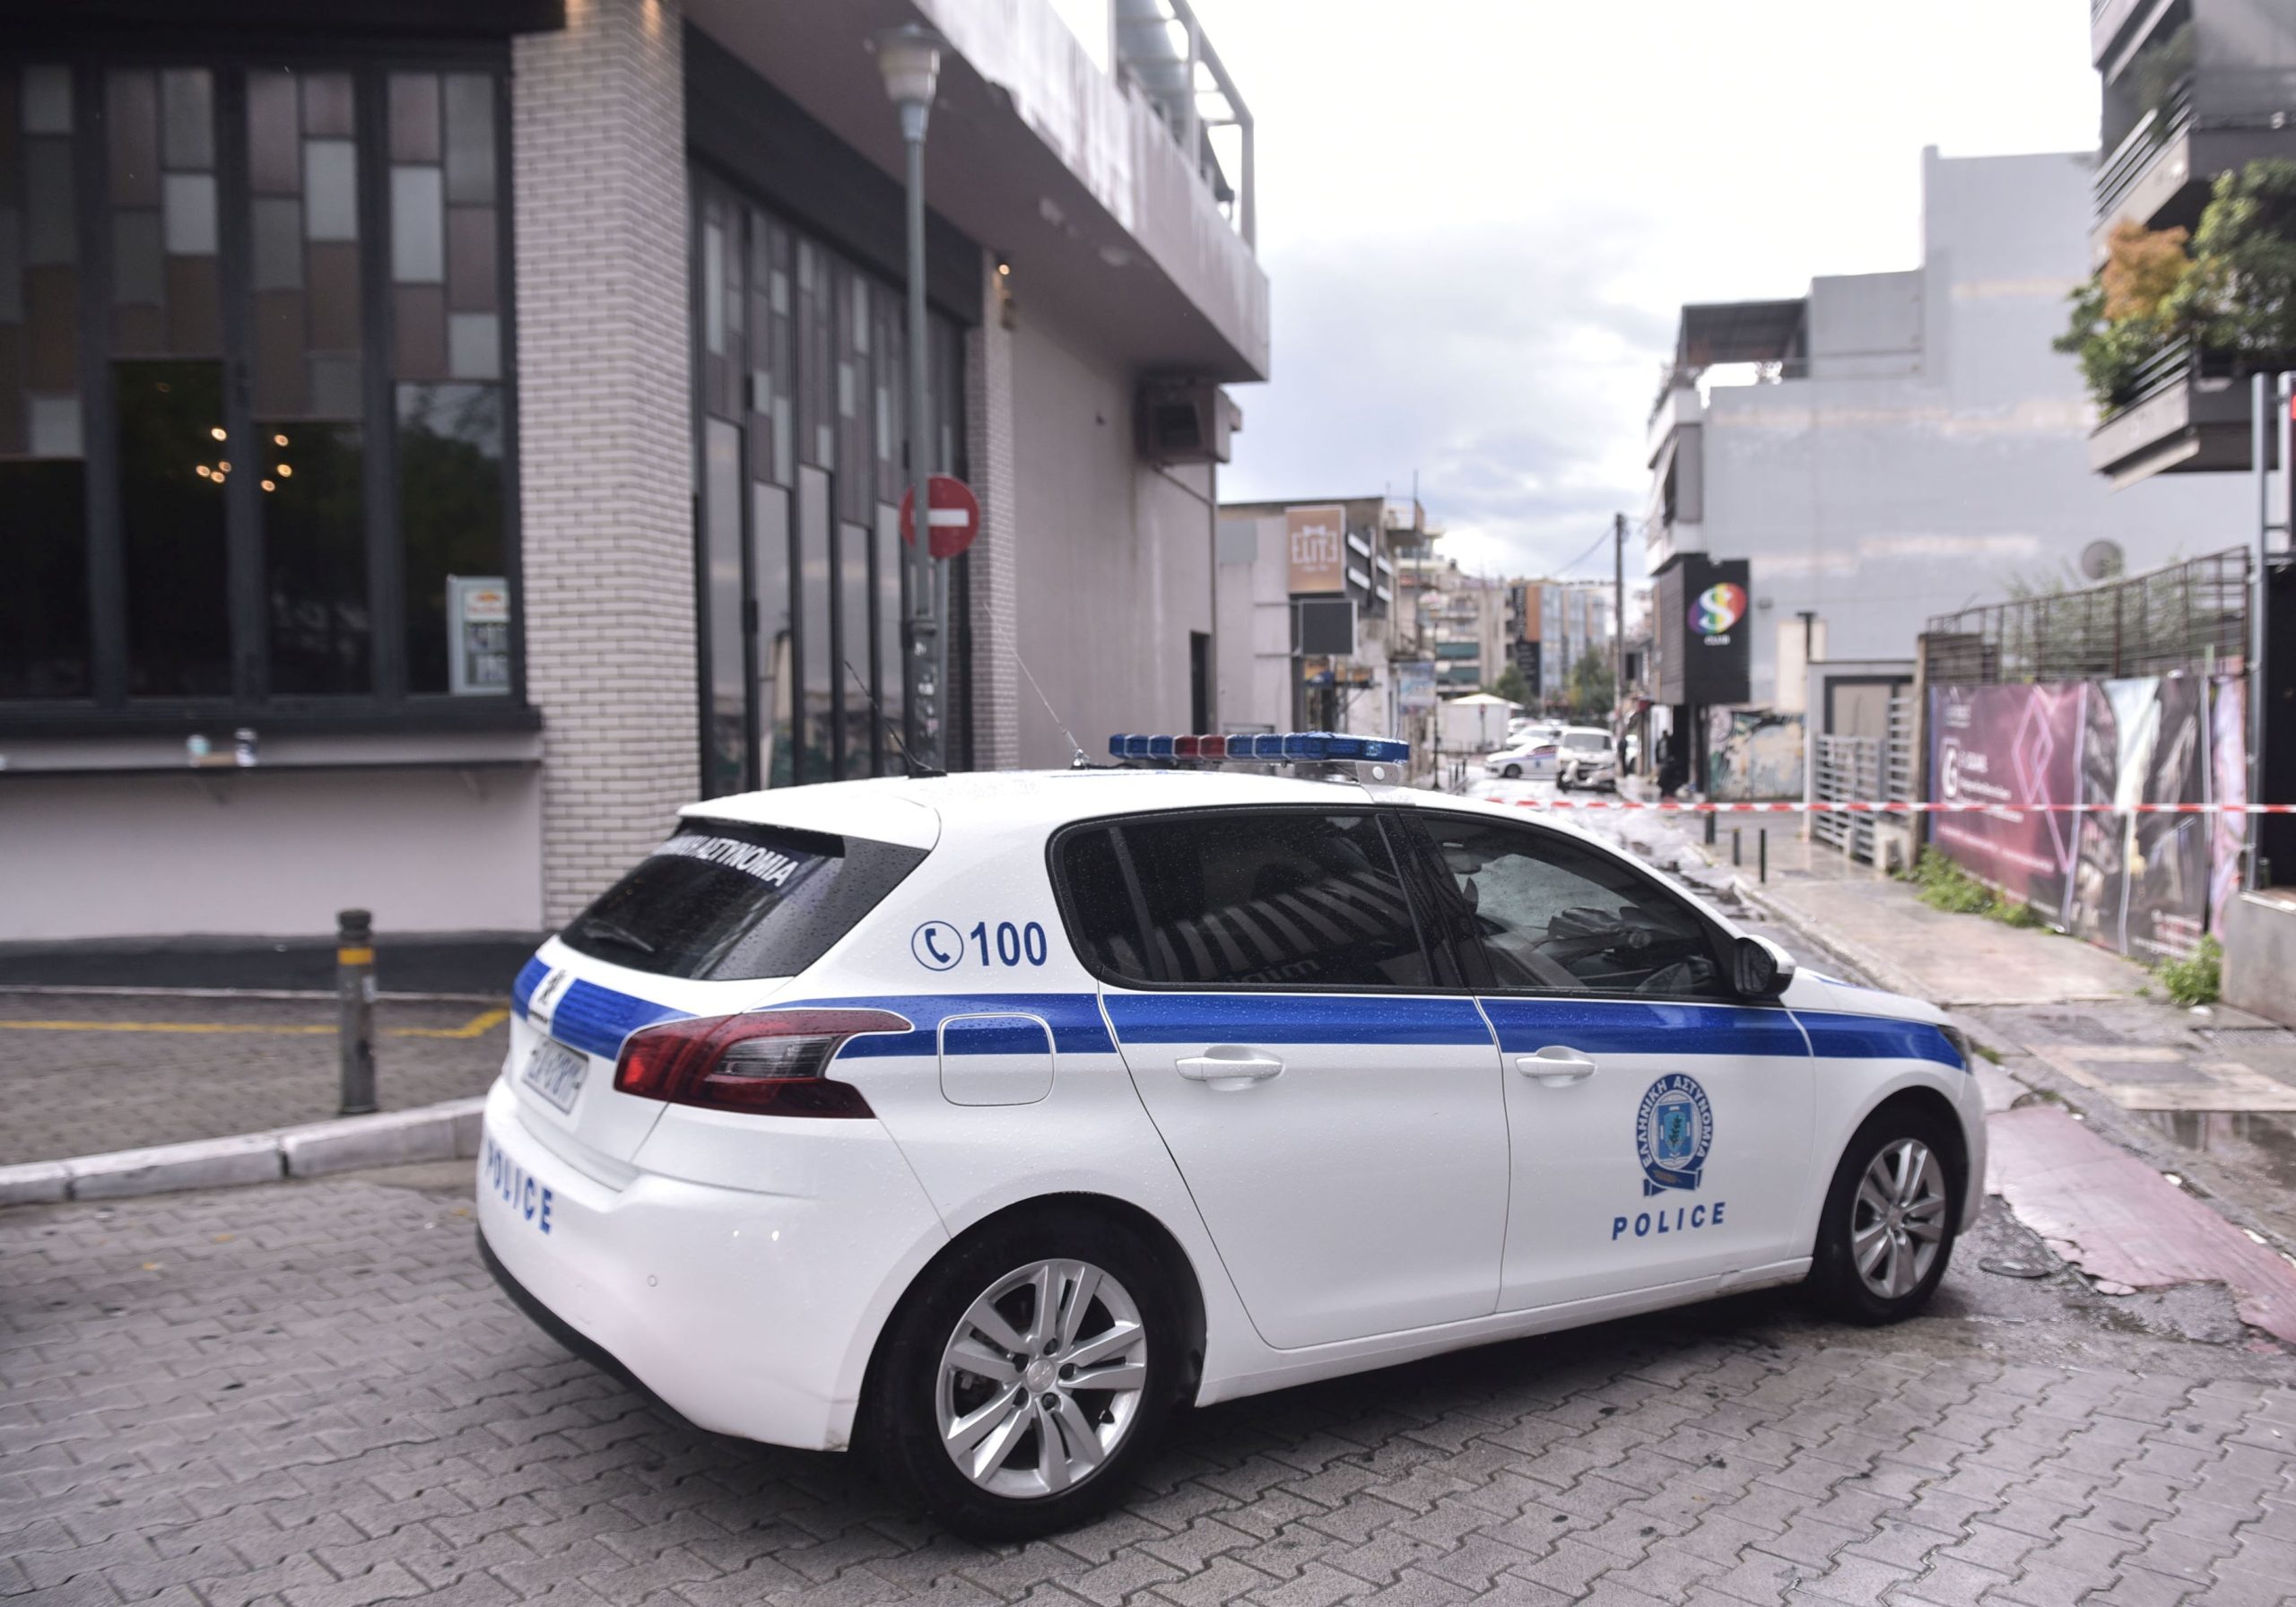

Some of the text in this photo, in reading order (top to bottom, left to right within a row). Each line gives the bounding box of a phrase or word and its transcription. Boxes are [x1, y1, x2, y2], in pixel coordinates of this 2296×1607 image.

[970, 921, 1047, 967] 100
[1638, 1075, 1711, 1168] ΕΛΛΗΝΙΚΗ ΑΣΤΥΝΟΜΙΑ
[485, 1138, 552, 1235] POLICE
[1612, 1202, 1726, 1241] POLICE
